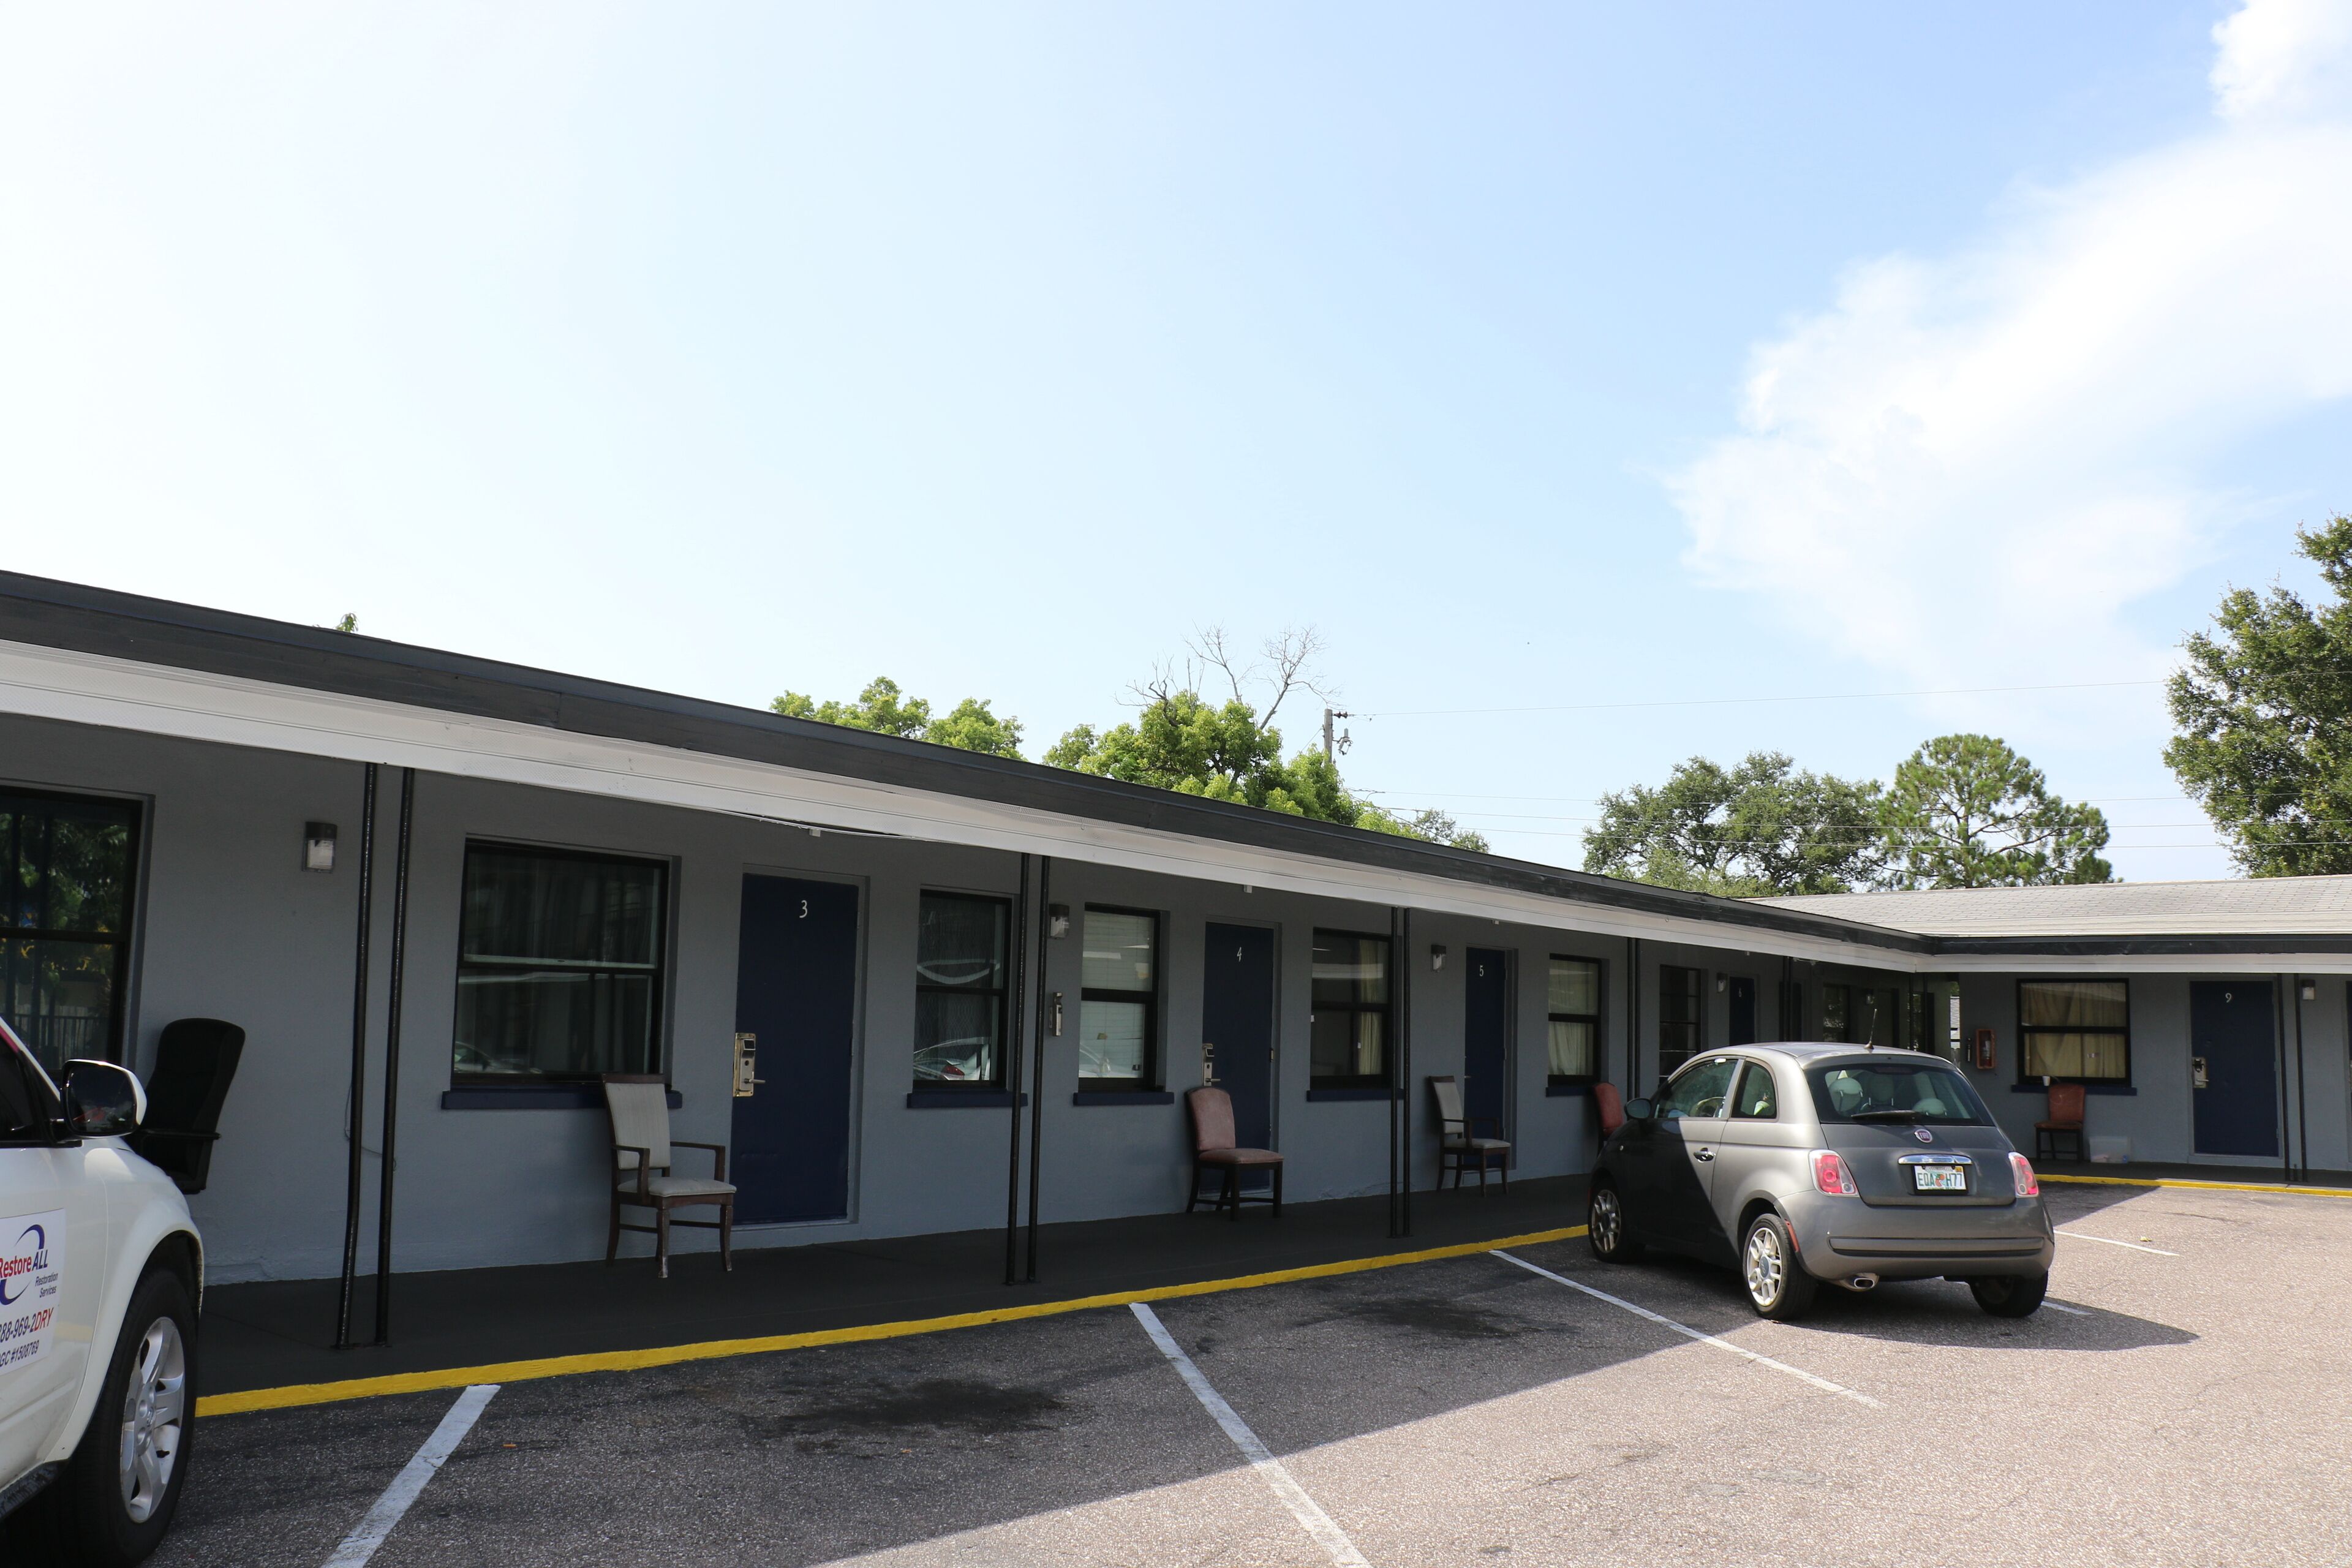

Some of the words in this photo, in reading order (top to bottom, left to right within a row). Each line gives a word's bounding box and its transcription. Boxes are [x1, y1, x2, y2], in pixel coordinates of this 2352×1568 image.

[799, 900, 808, 918] 3
[1237, 946, 1242, 962] 4
[1479, 965, 1484, 977] 5
[1738, 987, 1743, 997] 6
[2225, 993, 2232, 1003] 9
[1945, 1172, 1963, 1187] H77
[35, 1272, 59, 1287] Restoration
[39, 1285, 57, 1298] Services
